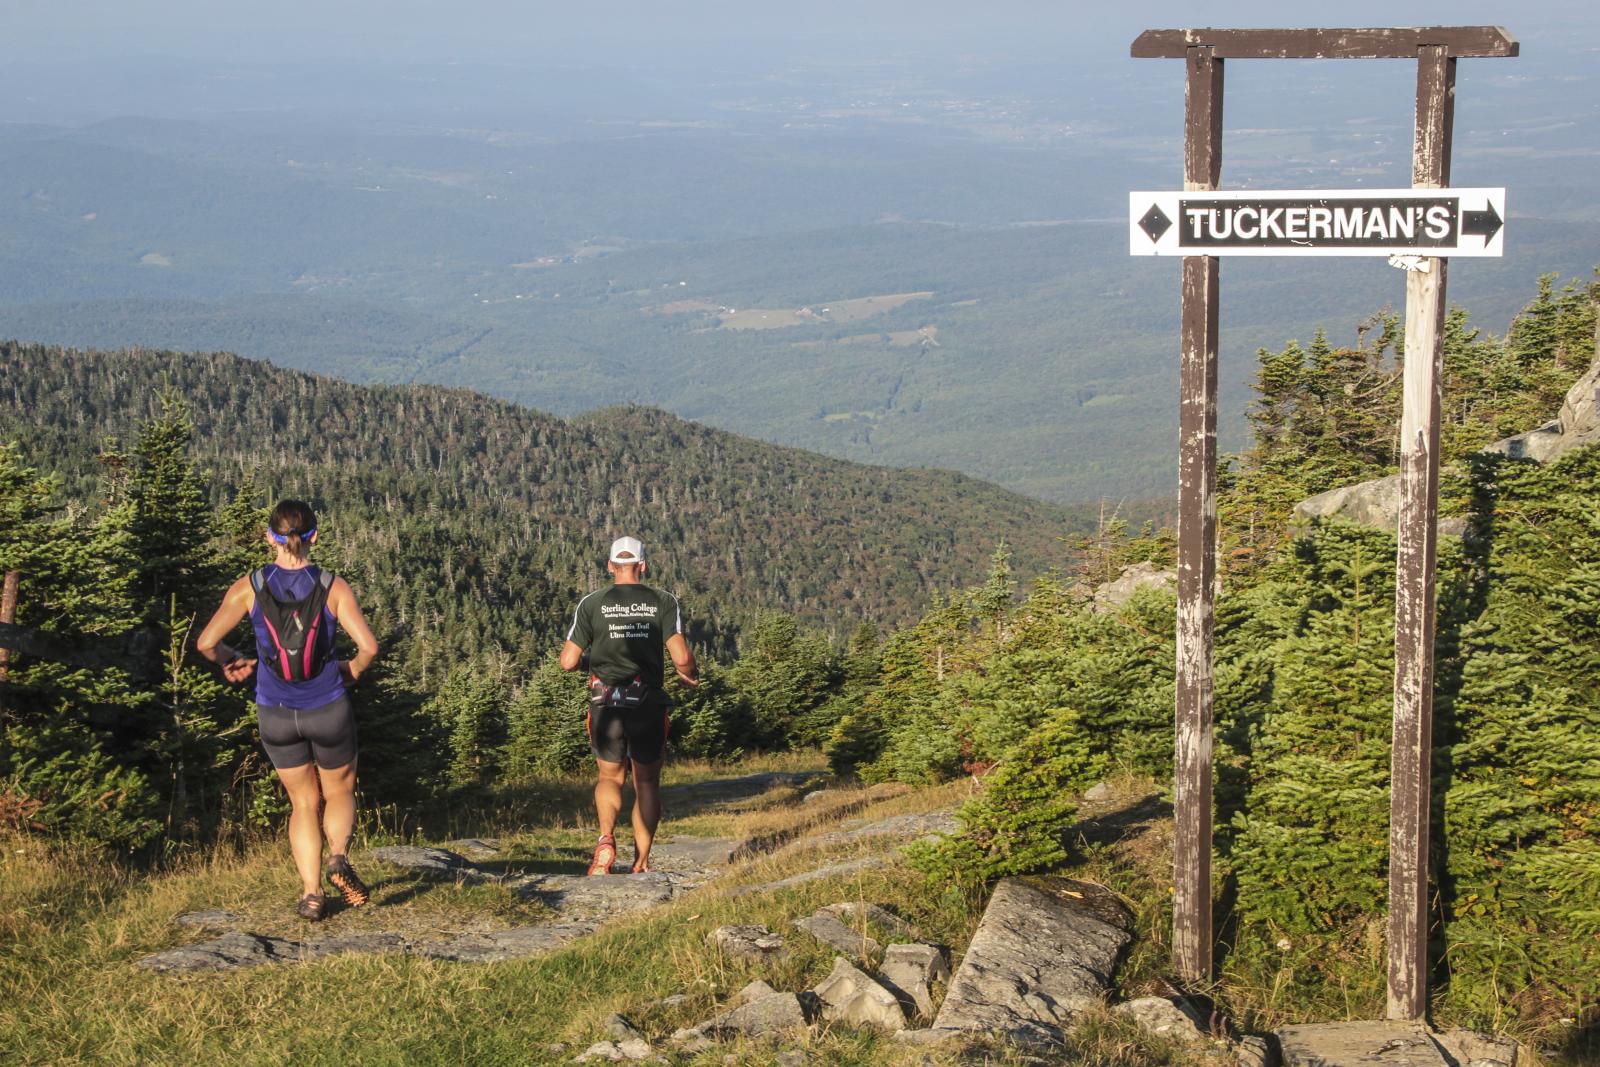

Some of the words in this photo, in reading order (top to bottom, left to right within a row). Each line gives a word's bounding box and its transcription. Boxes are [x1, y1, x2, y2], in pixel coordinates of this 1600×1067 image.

[1186, 206, 1451, 240] TUCKERMAN'S
[601, 603, 630, 614] Sterling
[630, 603, 658, 614] College
[608, 623, 635, 631] Mountain
[636, 622, 650, 630] Trail
[609, 631, 625, 639] Ultra
[625, 631, 649, 639] Running
